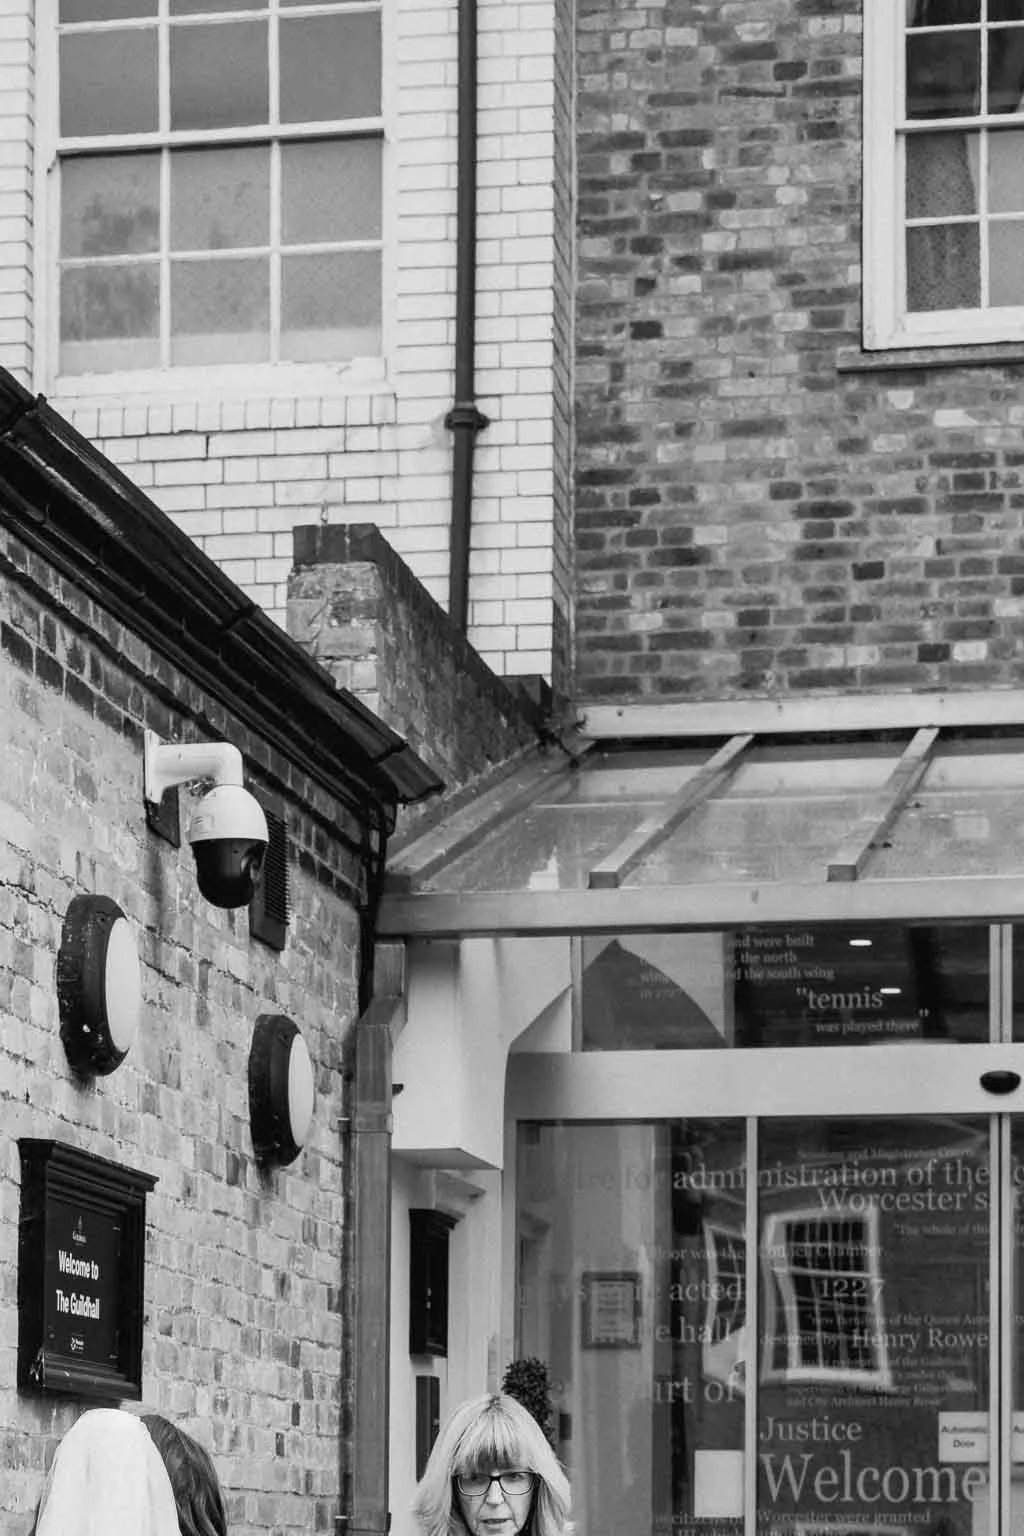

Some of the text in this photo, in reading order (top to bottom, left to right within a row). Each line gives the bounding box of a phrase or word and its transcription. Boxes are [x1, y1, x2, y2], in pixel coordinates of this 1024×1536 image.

[753, 937, 782, 948] were
[785, 934, 815, 948] built
[741, 952, 760, 963] the
[763, 951, 797, 963] north
[804, 967, 835, 981] wing
[816, 1021, 840, 1032] was
[842, 1018, 883, 1034] played
[673, 1161, 897, 1190] administration
[907, 1158, 939, 1187] of
[944, 1158, 989, 1187] the
[818, 1181, 988, 1212] Worcester's
[58, 1249, 99, 1281] Welcome to
[669, 1278, 742, 1302] acted
[821, 1278, 885, 1302] 1227
[56, 1288, 100, 1320] The Guildhall
[679, 1315, 732, 1344] hall
[853, 1327, 920, 1352] Henry
[928, 1327, 989, 1348] Rowe
[759, 1415, 863, 1442] Justice
[759, 1449, 987, 1504] Welcome
[875, 1509, 931, 1527] granted
